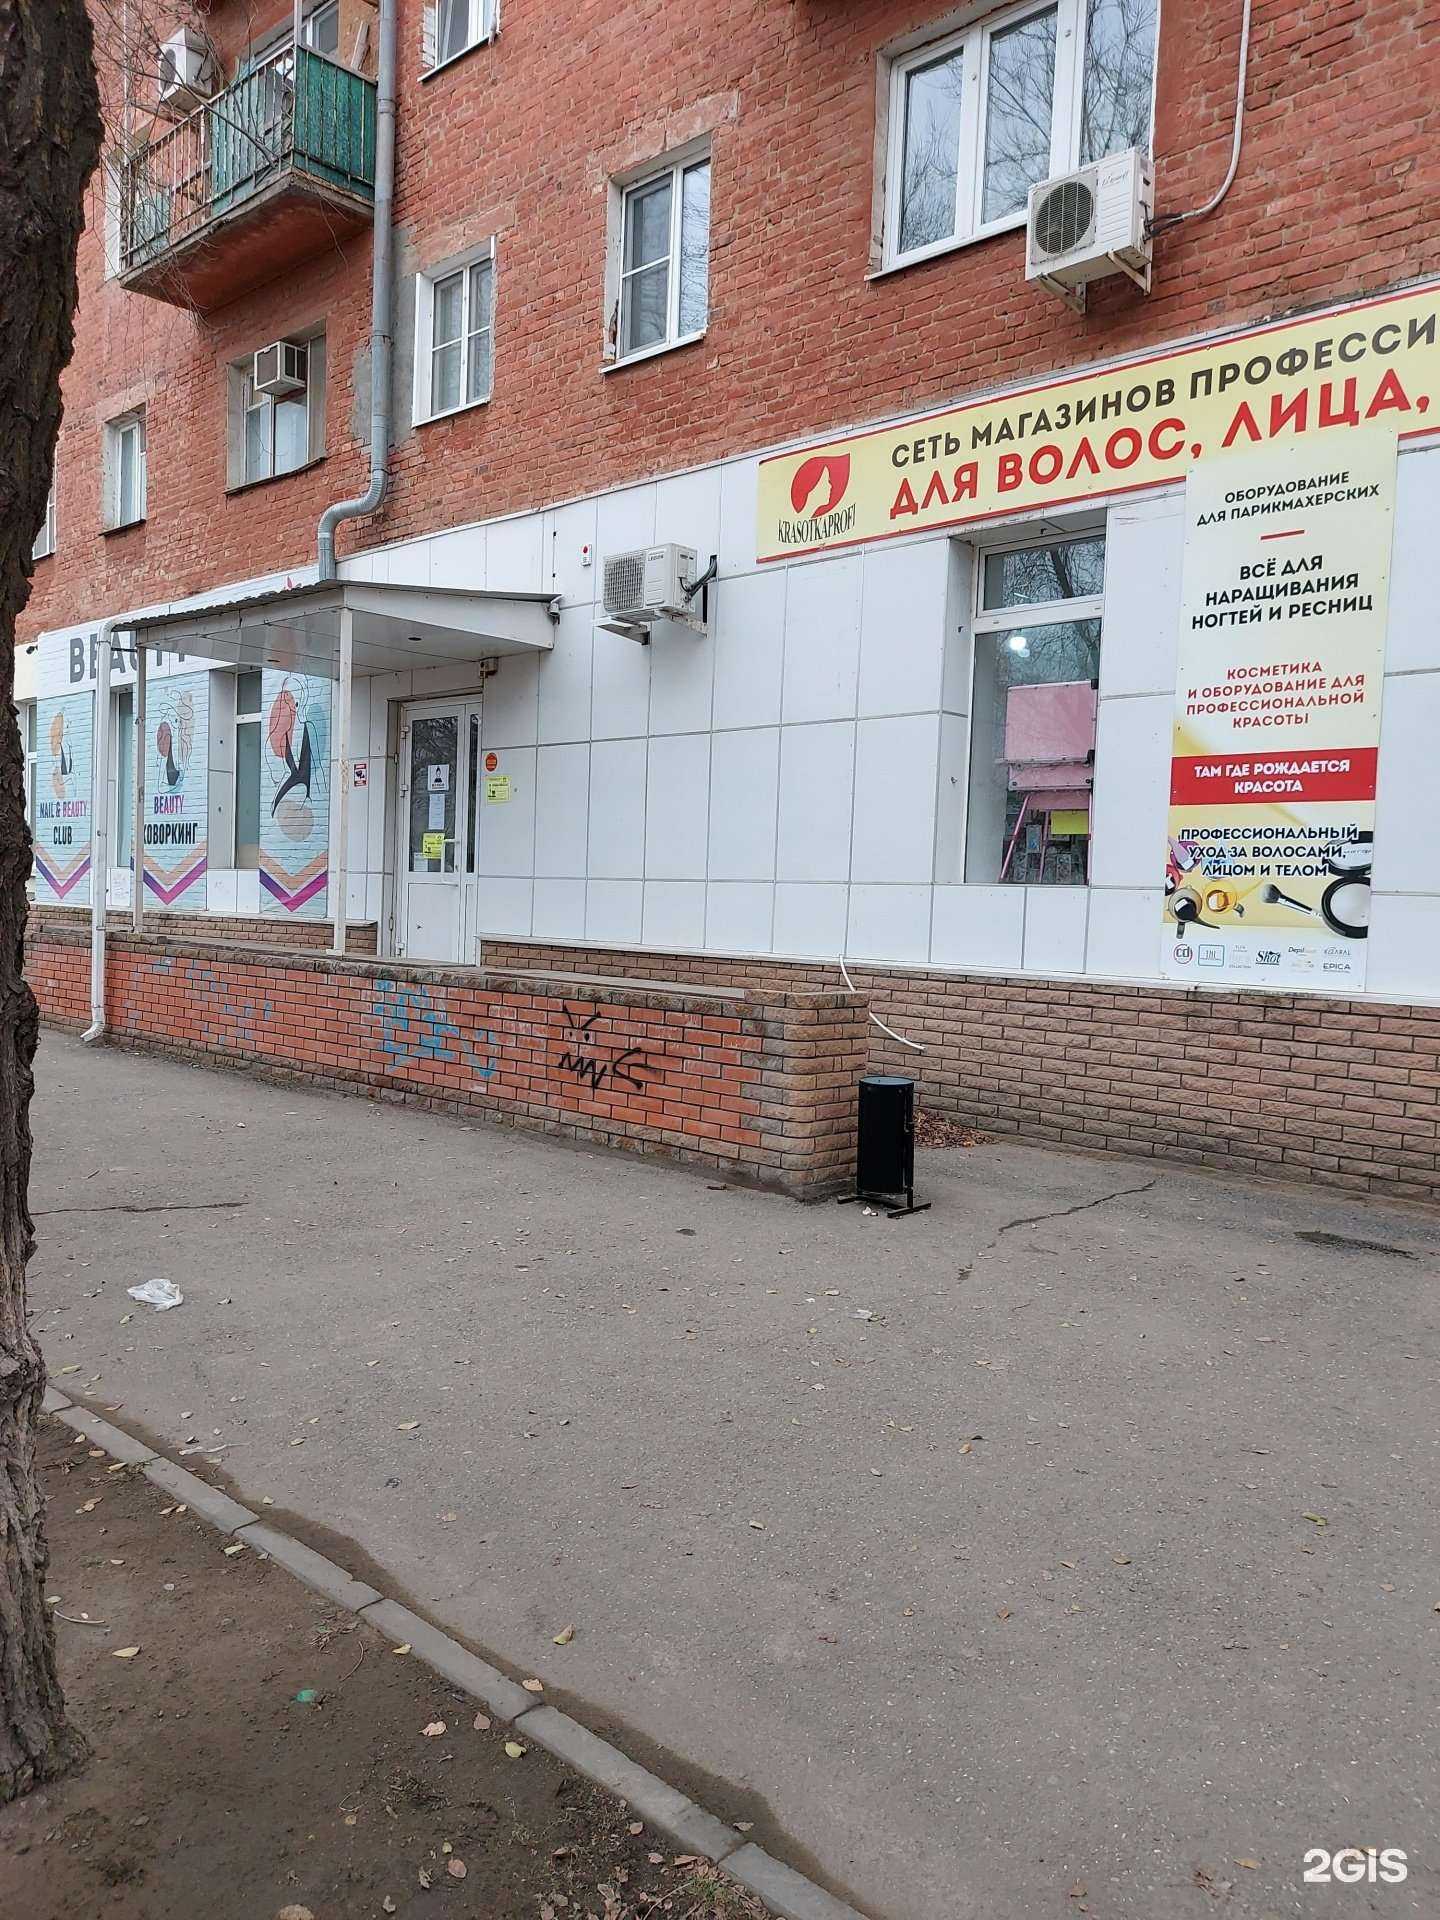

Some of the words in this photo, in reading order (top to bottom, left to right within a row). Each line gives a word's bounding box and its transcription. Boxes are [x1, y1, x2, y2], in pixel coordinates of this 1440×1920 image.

[891, 432, 961, 468] СЕТЬ
[971, 379, 1176, 450] МАГАЗИНОВ
[1189, 313, 1436, 399] ПРОФЕССИ
[889, 461, 979, 520] ДЛЯ
[997, 417, 1202, 493] ВОЛОС,
[1222, 367, 1430, 448] ЛИЦА,
[1225, 472, 1349, 504] ОБОРУДОВАНИЕ
[1197, 511, 1226, 526] ДЛЯ
[1231, 484, 1380, 520] ПАРИКМАХЕРСКИХ
[778, 503, 857, 544] KRASOTKAPROFI
[1239, 559, 1276, 580] ВСЁ
[1281, 555, 1323, 577] ДЛЯ
[1205, 573, 1359, 606] НАРАЩИВАНИЯ
[1191, 605, 1263, 630] НОГТЕЙ
[1268, 605, 1282, 621] И
[1288, 594, 1373, 619] РЕСНИЦ
[1227, 661, 1322, 681] КОСМЕТИКА
[1187, 688, 1197, 699] И
[1201, 679, 1327, 699] ОБОРУДОВАНИЕ
[1331, 674, 1365, 688] ДЛЯ
[1186, 690, 1364, 716] ПРОФЕССИОНАЛЬНОЙ
[1232, 714, 1309, 729] КРАСОТЫ
[1194, 766, 1222, 778] ТАМ
[1225, 764, 1250, 777] ГДЕ
[1253, 759, 1350, 776] РОЖДАЕТСЯ
[1234, 780, 1303, 794] КРАСОТА
[40, 802, 54, 818] NAIL
[63, 800, 87, 817] BEAUTY
[154, 795, 185, 814] BEAUTY
[53, 826, 72, 845] CLUB
[1181, 825, 1358, 841] ПРОФЕССИОНАЛЬНЫЙ
[1189, 847, 1227, 859] УХОД
[1231, 846, 1248, 858] ЗА
[1252, 845, 1347, 859] ВОЛОСАМИ,
[1202, 864, 1255, 878] ЛИЦОМ
[1260, 864, 1270, 876] И
[1276, 863, 1327, 876] ТЕЛОМ
[1323, 962, 1351, 970] EPICA
